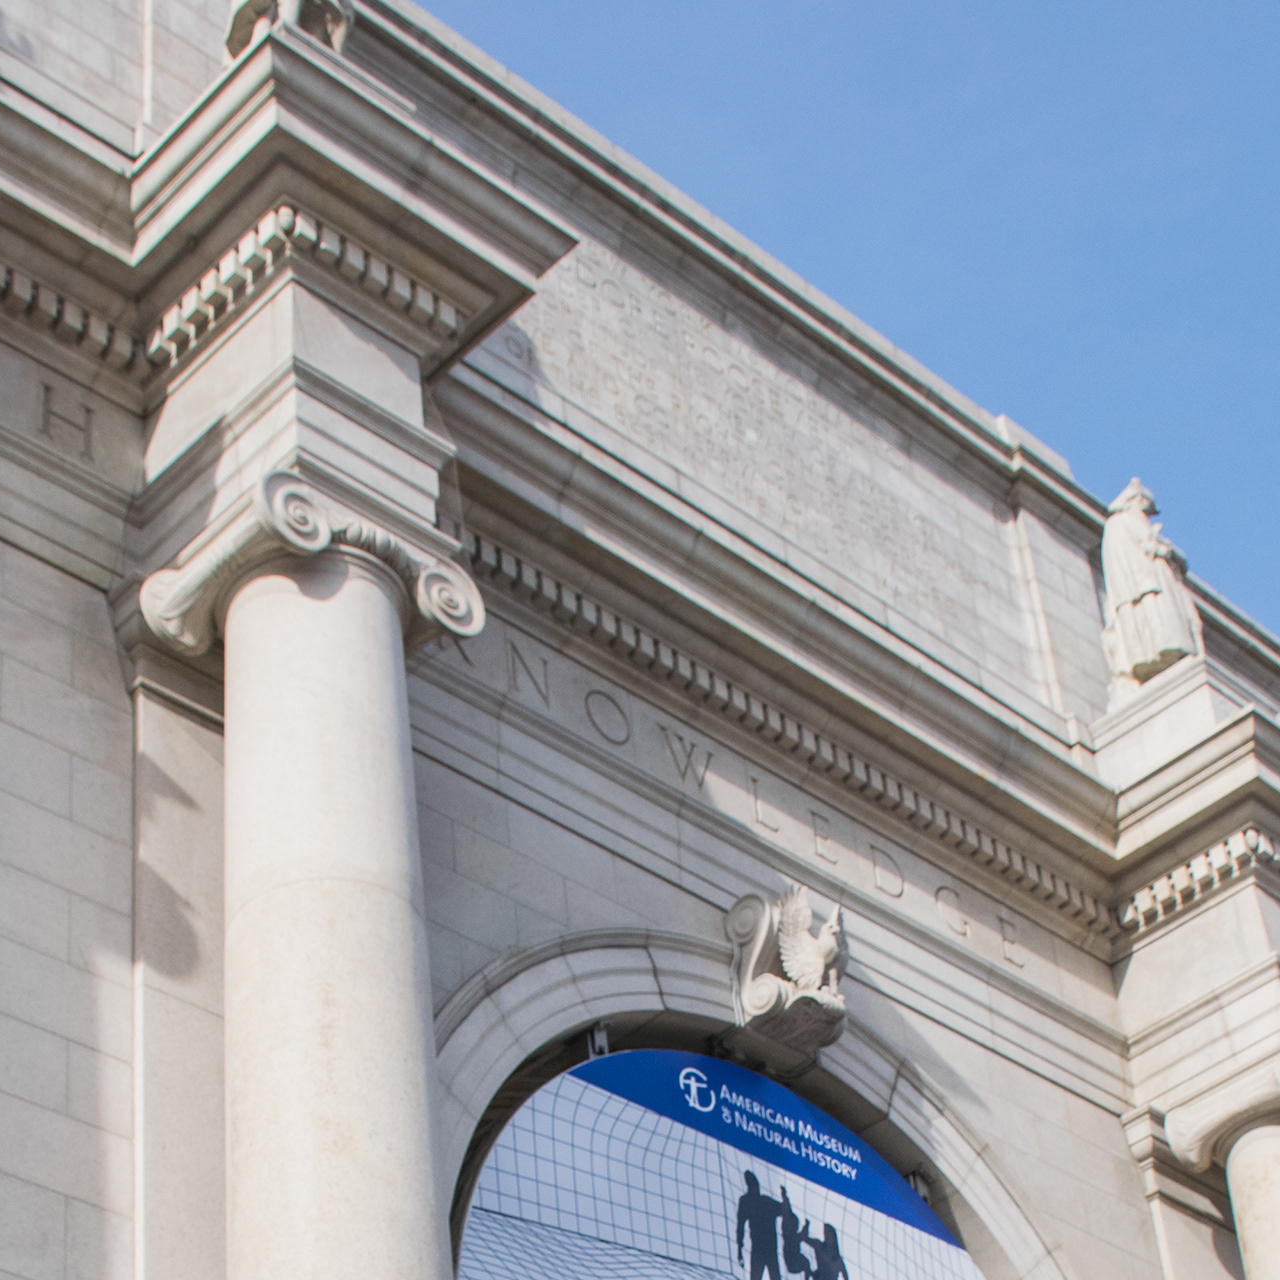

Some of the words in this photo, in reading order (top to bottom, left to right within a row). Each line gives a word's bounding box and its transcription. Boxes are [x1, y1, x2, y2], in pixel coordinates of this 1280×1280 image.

[720, 1083, 796, 1133] AMERICAN
[798, 1119, 862, 1164] MUSEUM
[734, 1110, 800, 1156] NATURAL
[801, 1142, 858, 1181] HISTORY
